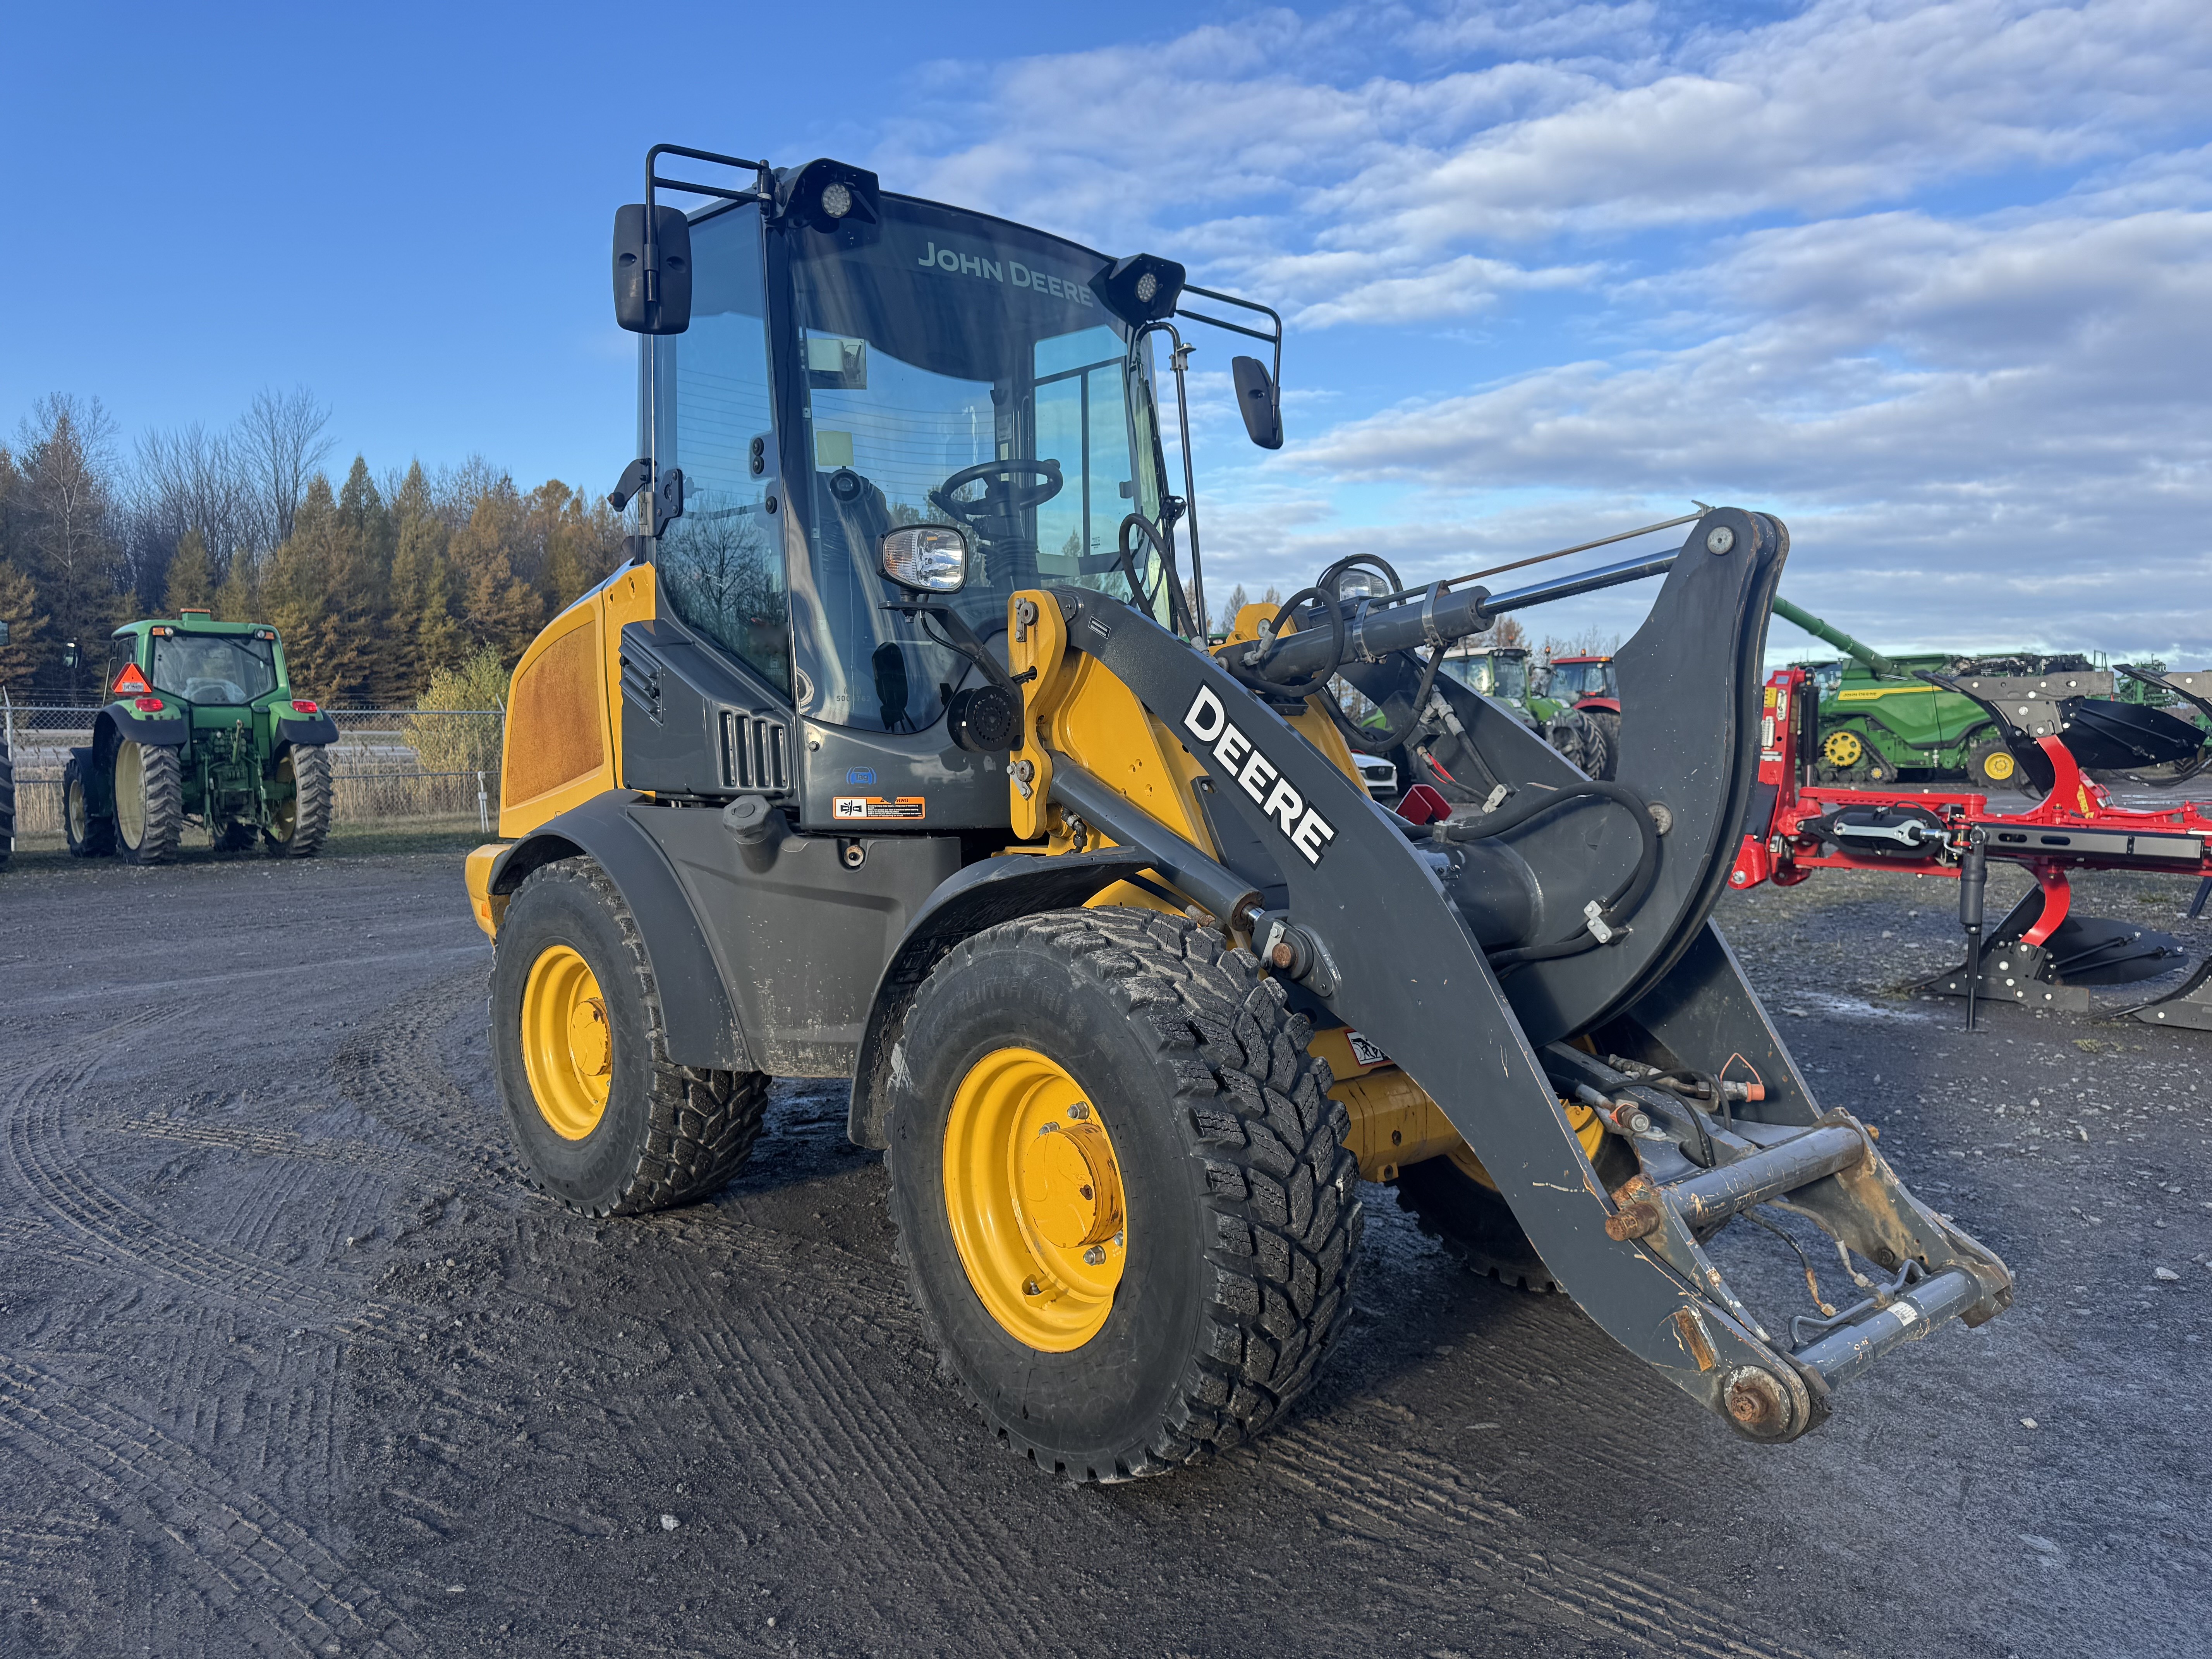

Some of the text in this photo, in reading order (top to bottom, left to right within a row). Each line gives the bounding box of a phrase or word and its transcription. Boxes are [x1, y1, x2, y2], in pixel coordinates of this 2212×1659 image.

[918, 242, 1093, 307] JOHN DEERE
[854, 773, 868, 781] Tag
[1184, 685, 1334, 864] DEERE
